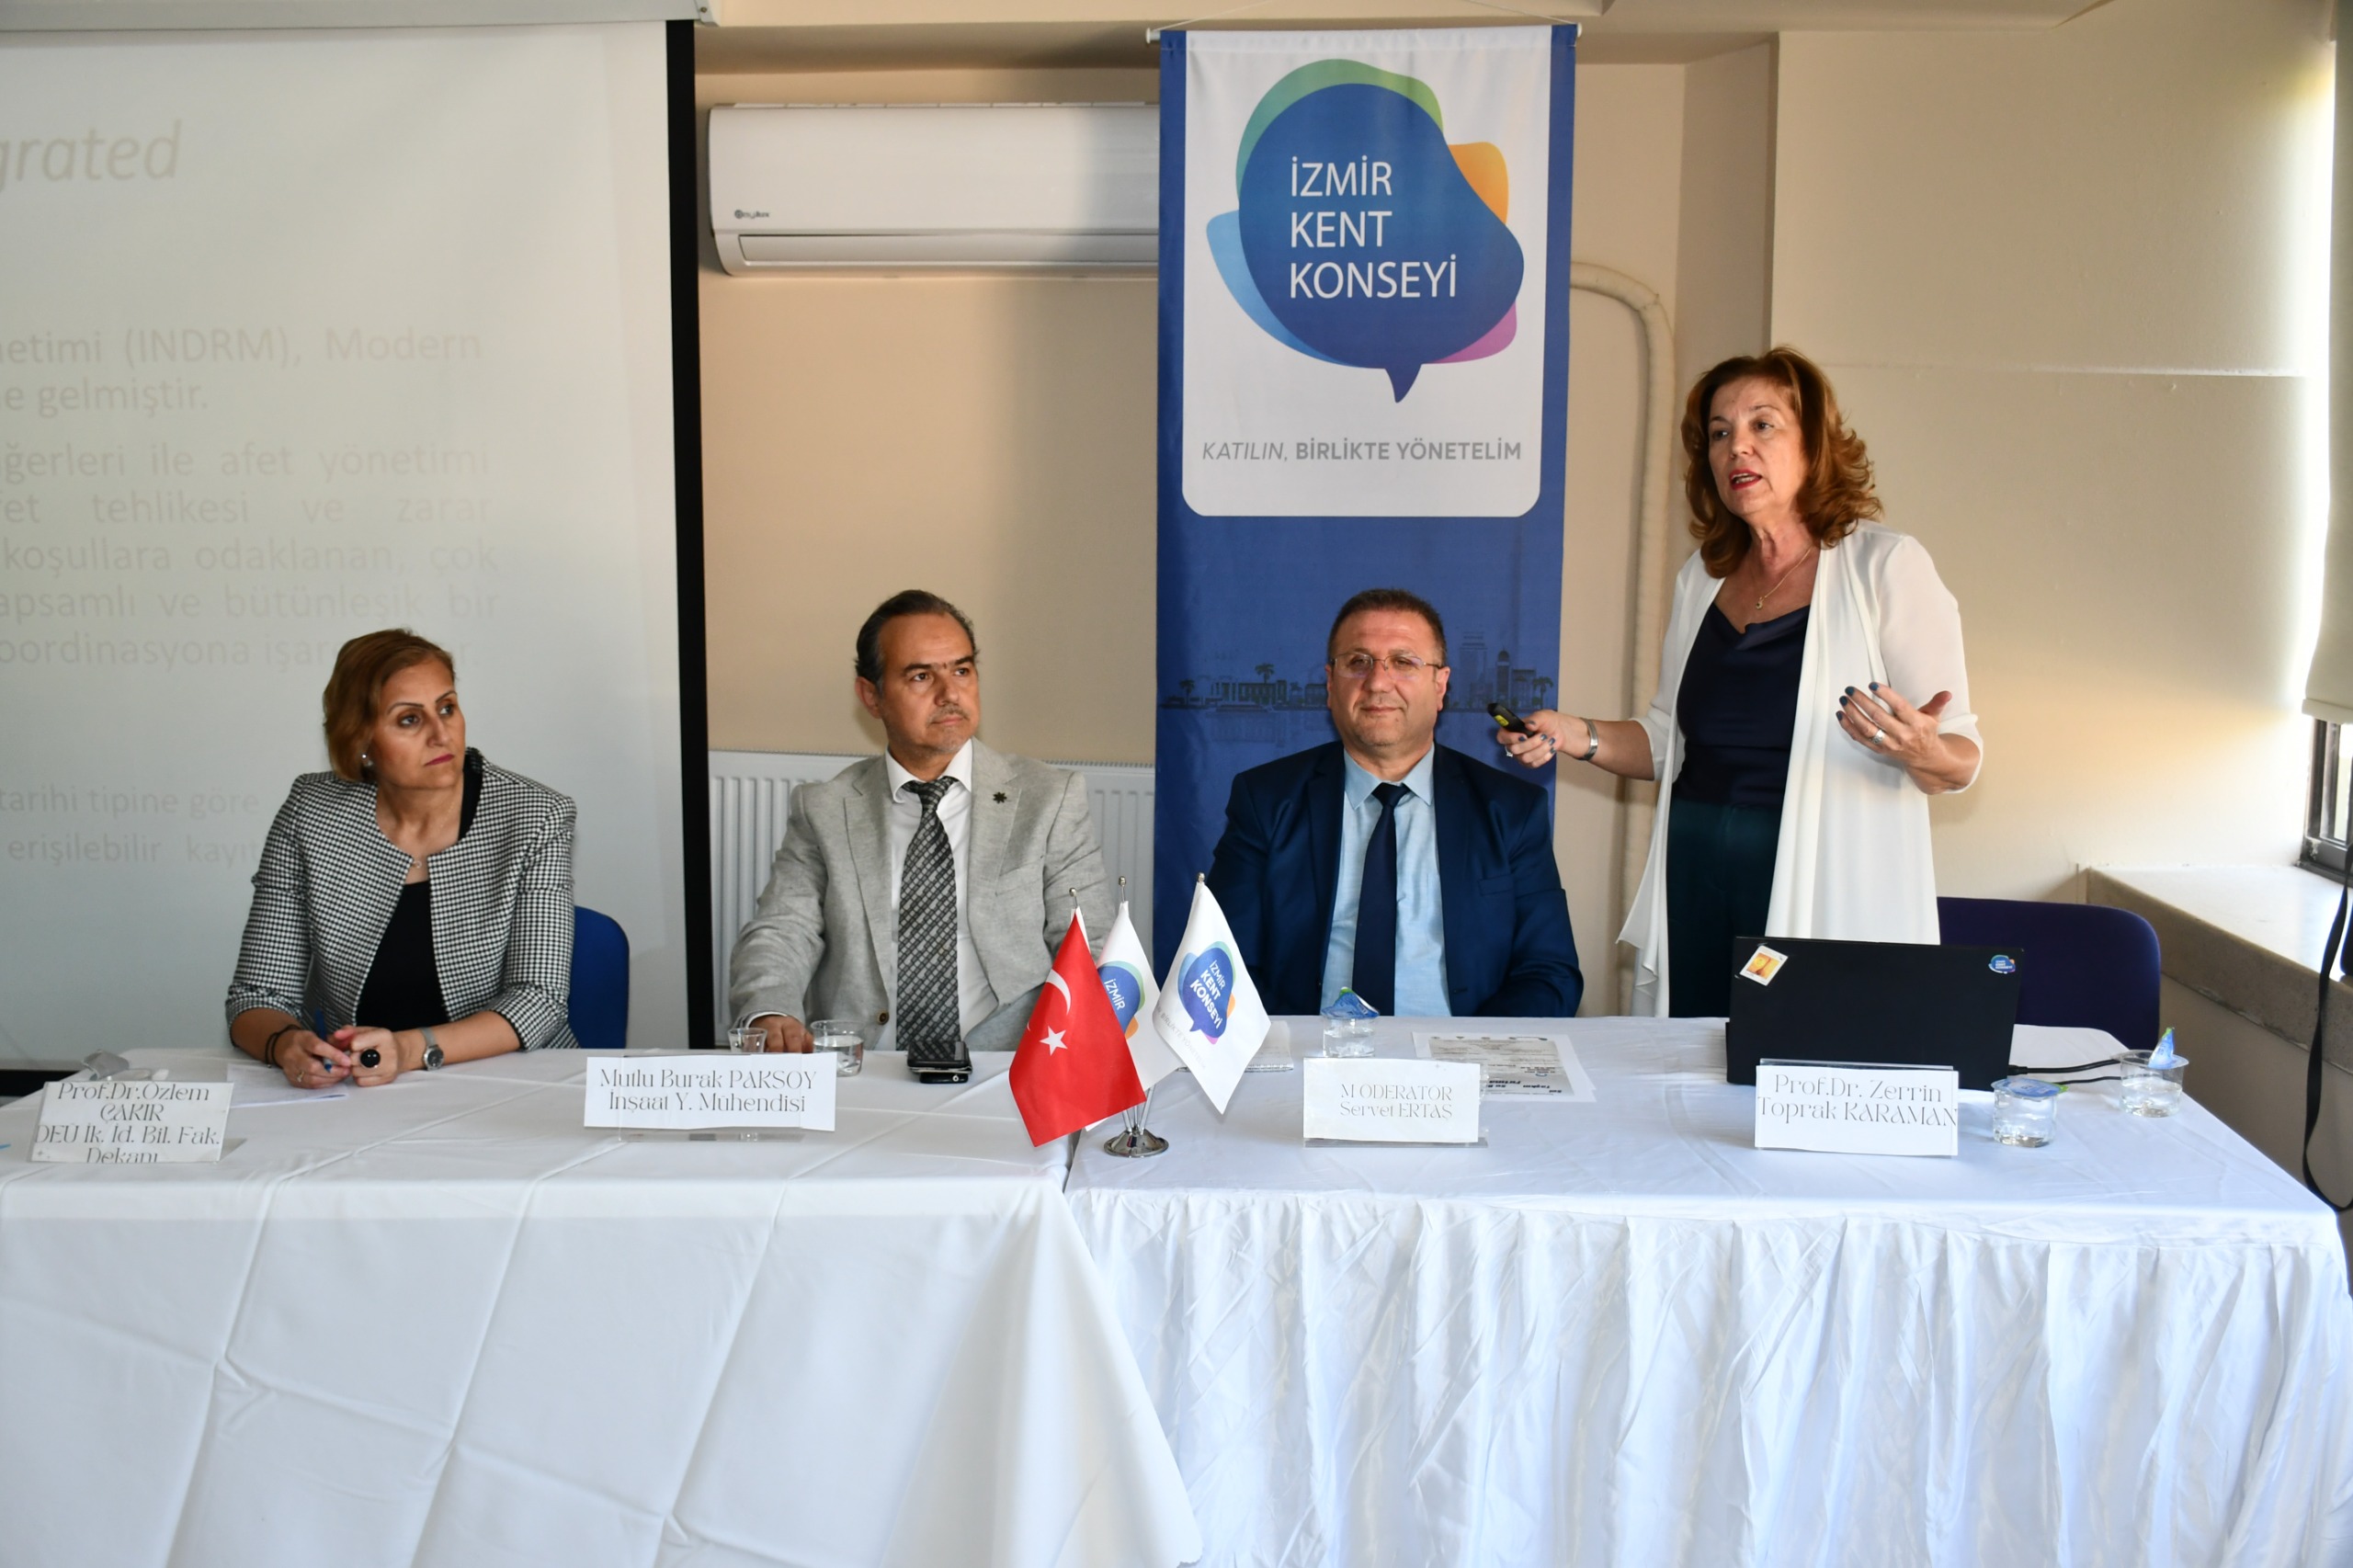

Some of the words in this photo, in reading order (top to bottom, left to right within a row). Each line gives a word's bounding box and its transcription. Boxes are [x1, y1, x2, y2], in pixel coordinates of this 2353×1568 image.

[1291, 154, 1392, 198] İZMİR
[1290, 210, 1392, 248] KENT
[1290, 254, 1457, 299] KONSEYİ
[0, 330, 102, 364] etimi
[124, 326, 301, 369] (INDRM),
[325, 326, 483, 362] Modern
[38, 377, 209, 419] gelmiştir.
[5, 441, 126, 485] ğerleri
[152, 442, 194, 476] ile
[221, 442, 294, 476] afet
[319, 444, 490, 483] yönetimi
[1202, 442, 1289, 462] KATILIN,
[1296, 437, 1390, 460] BİRLİKTE
[1396, 437, 1521, 460] YÖNETELİM
[0, 489, 40, 524] et
[92, 490, 249, 524] tehlikesi
[301, 498, 345, 523] ve
[396, 495, 492, 523] zarar
[4, 537, 172, 578] koşullara
[157, 591, 201, 618] ve
[225, 583, 425, 624] bütünleşik
[449, 583, 500, 618] bir
[266, 633, 334, 673] işar
[88, 786, 179, 819] tipine
[188, 787, 260, 821] göre
[7, 831, 162, 867] erişilebilir
[1104, 978, 1126, 1010] İZMİR
[1190, 979, 1222, 1028] KONSEYİ
[1200, 970, 1222, 1000] KENT
[600, 1069, 654, 1088] Mutlu
[661, 1069, 722, 1088] Burak
[729, 1070, 817, 1089] PAKSOY
[1870, 1080, 1941, 1103] Zerrin
[1757, 1096, 1836, 1124] Toprak
[1845, 1101, 1959, 1127] KARAMAN
